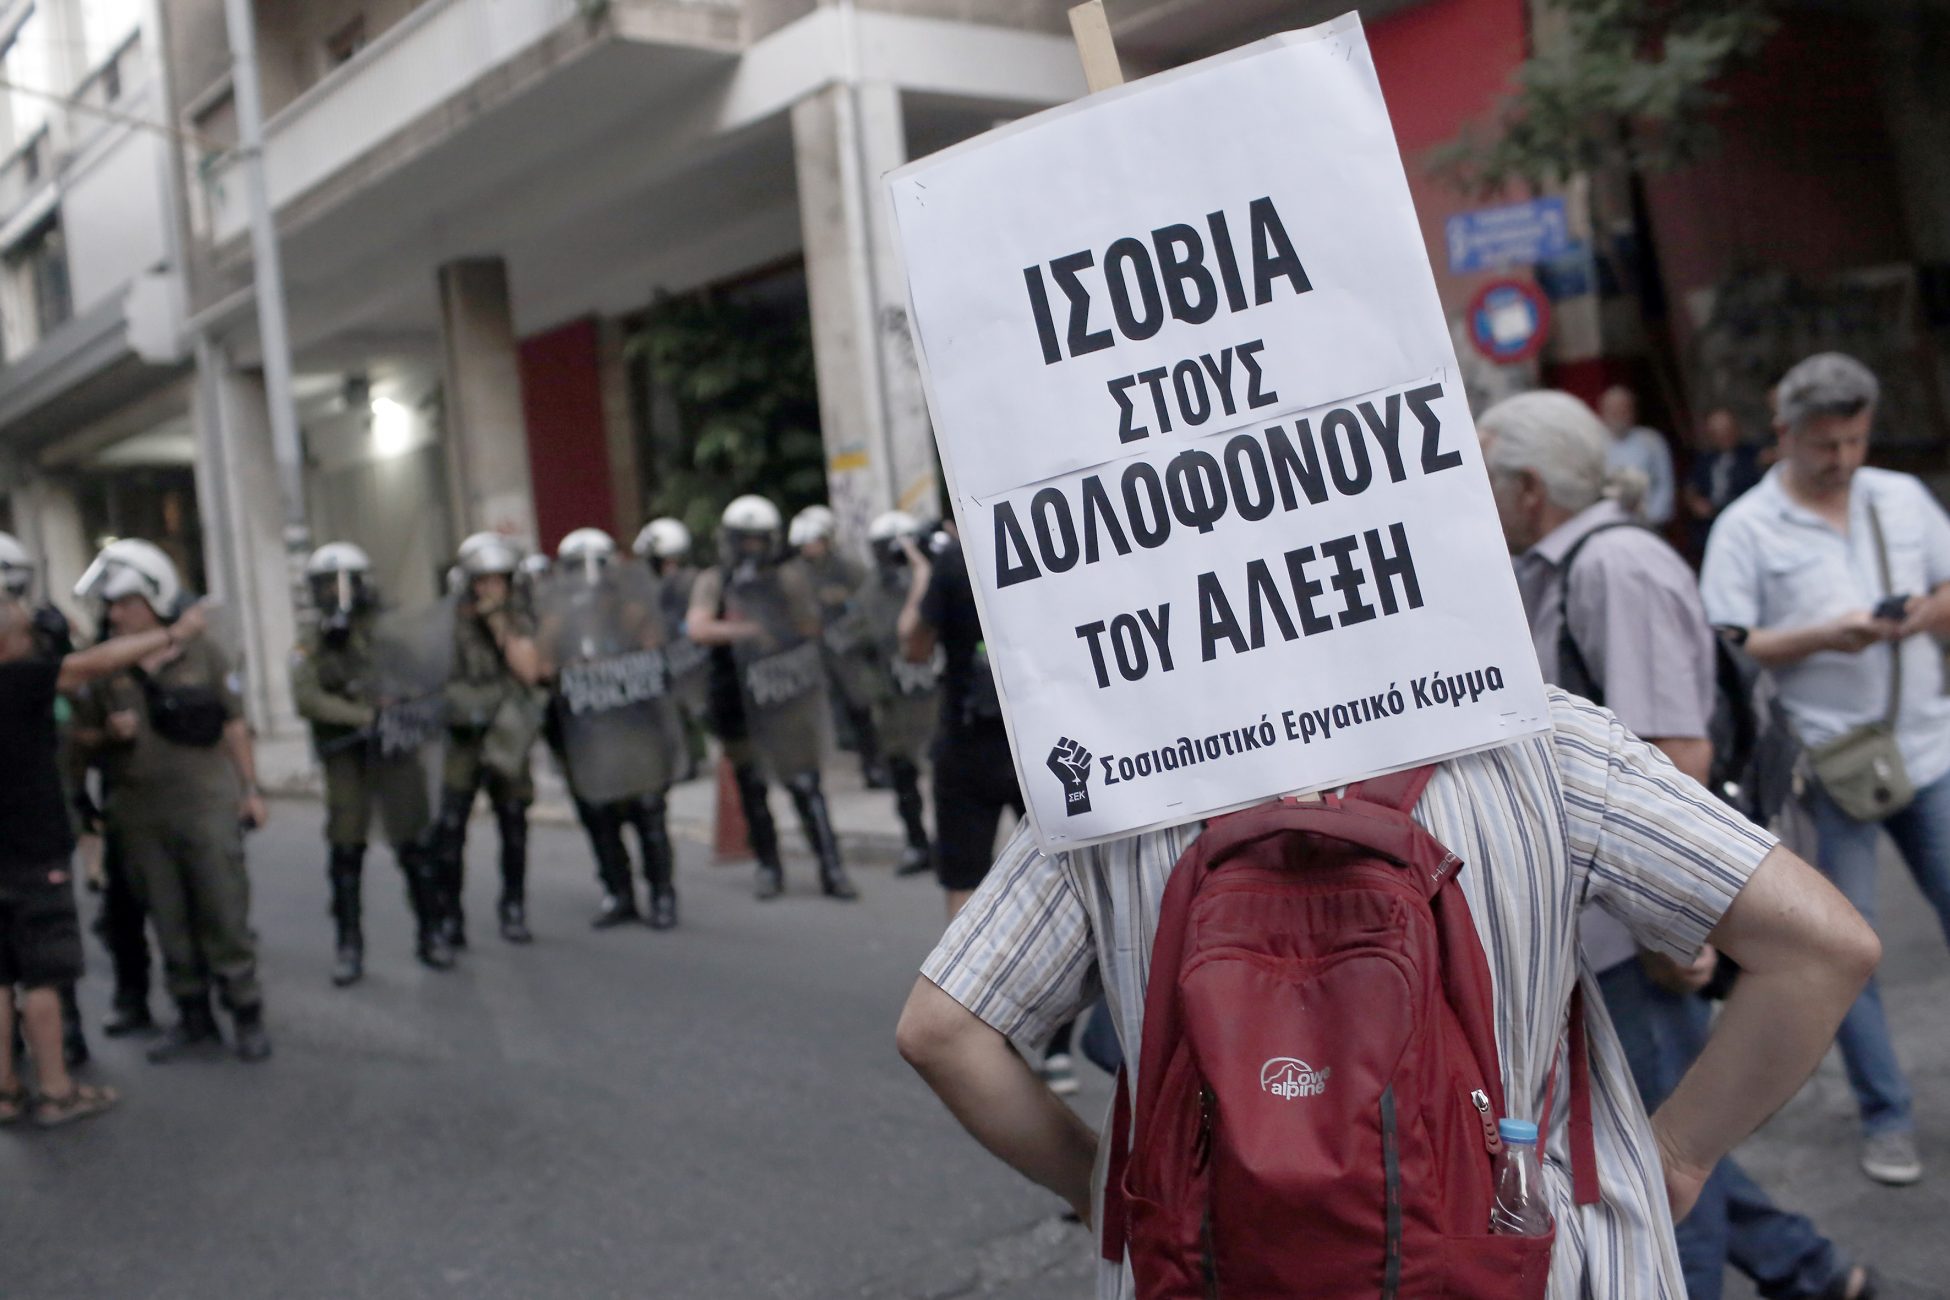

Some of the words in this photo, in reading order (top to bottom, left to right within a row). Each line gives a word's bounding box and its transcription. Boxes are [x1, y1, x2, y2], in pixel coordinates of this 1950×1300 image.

[1024, 197, 1313, 365] ΙΣΟΒΙΑ
[1107, 339, 1278, 444] ΣΤΟΥΣ
[994, 382, 1463, 589] ΔΟΛΟΦΟΝΟΥΣ
[1075, 603, 1175, 689] ΤΟΥ
[1198, 522, 1425, 663] ΑΛΕΞΗ
[1099, 714, 1277, 786] Σοσιαλιστικό
[1281, 681, 1405, 744] Εργατικό
[1410, 666, 1505, 709] Κόμμα
[1068, 790, 1086, 803] ΣΕΚ
[1271, 1080, 1326, 1101] alpine
[1287, 1066, 1331, 1086] Lowe
